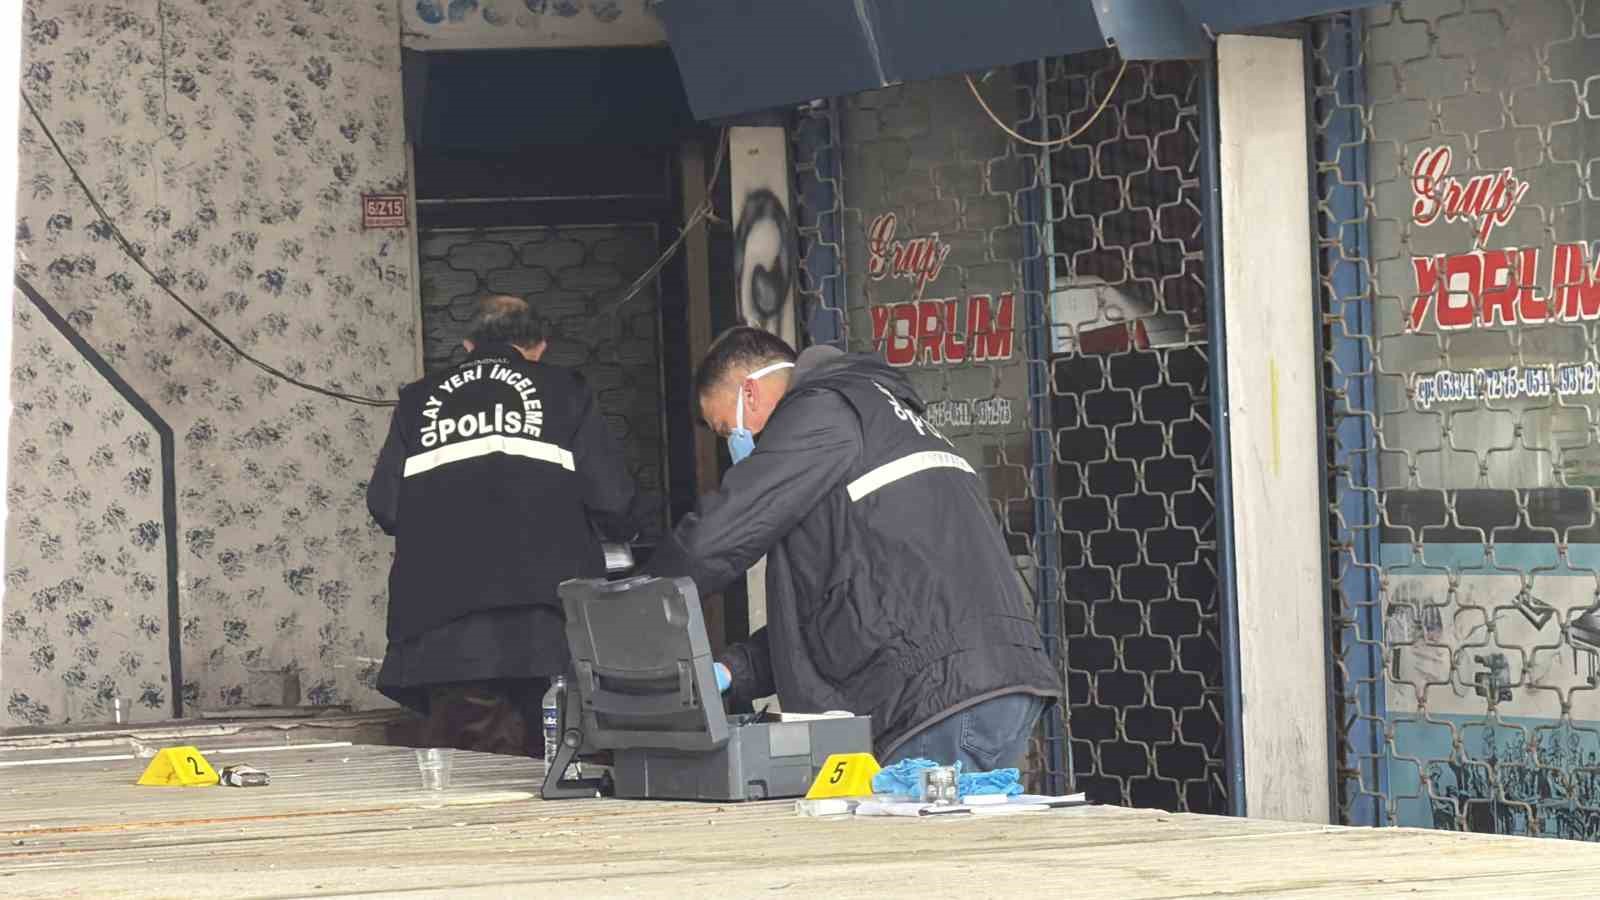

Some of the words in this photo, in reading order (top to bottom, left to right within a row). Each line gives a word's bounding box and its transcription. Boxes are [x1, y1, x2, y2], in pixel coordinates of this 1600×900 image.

[1412, 146, 1529, 249] Grup
[868, 211, 950, 300] Grup
[870, 292, 1015, 366] YORUM
[420, 395, 443, 448] OLAY
[489, 364, 543, 437] İNCELEME
[186, 756, 205, 776] 2
[829, 761, 848, 784] 5
